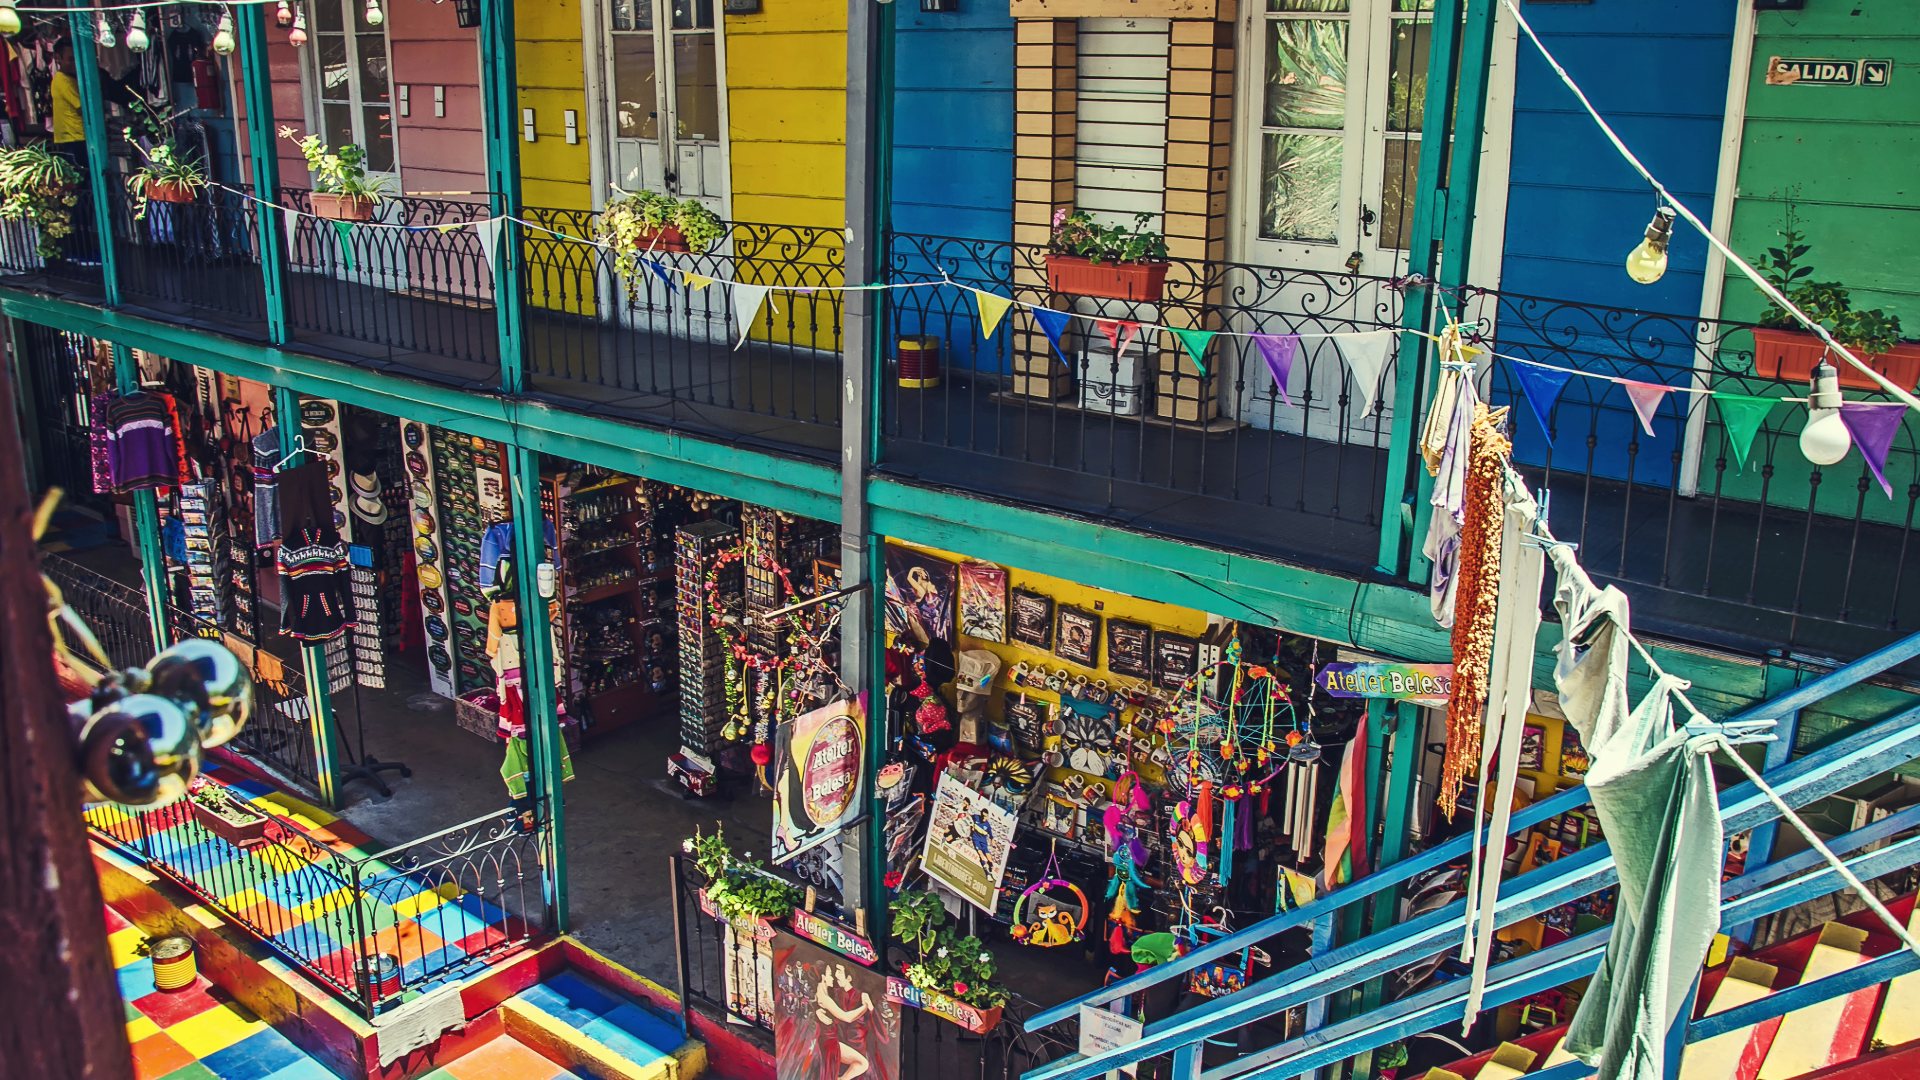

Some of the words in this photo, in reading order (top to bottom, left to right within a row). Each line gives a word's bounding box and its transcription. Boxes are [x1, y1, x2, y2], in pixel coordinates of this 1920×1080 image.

[1326, 671, 1388, 693] Atelier
[813, 738, 854, 769] Atelier
[811, 771, 851, 801] Belesa
[933, 852, 972, 886] LIBERTADORES
[796, 913, 834, 944] Atelier
[836, 931, 874, 961] Belesa
[888, 981, 931, 1007] Atelier
